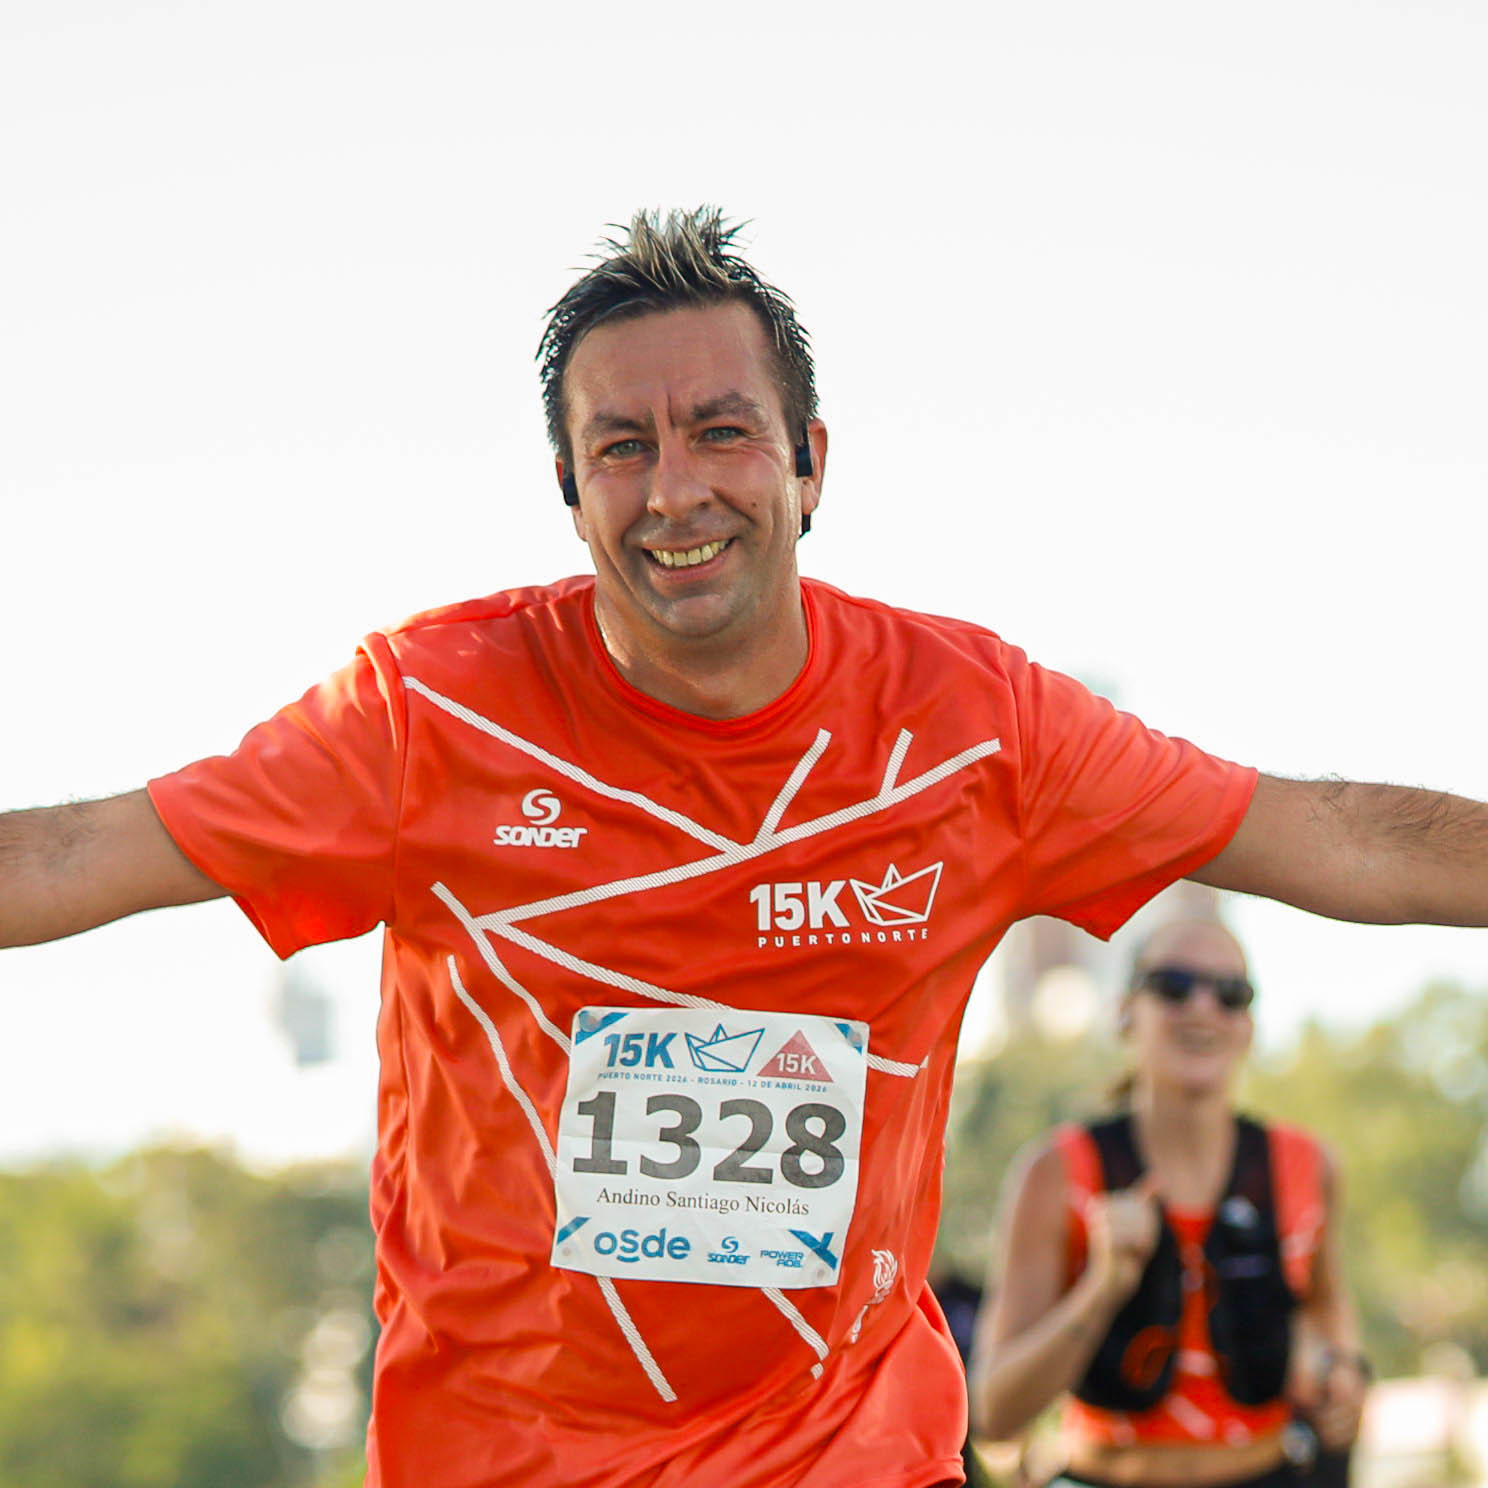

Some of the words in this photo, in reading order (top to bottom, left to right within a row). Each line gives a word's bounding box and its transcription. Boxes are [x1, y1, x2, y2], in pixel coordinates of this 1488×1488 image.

[750, 880, 851, 931] 15K
[758, 933, 852, 948] PUERTO
[861, 928, 929, 943] NORTE
[603, 1032, 678, 1069] 15K
[775, 1052, 817, 1075] 15K
[598, 1072, 631, 1080] PUERTO
[634, 1073, 663, 1081] NORTE
[698, 1076, 737, 1086] ROSARIO
[761, 1081, 772, 1089] DE
[776, 1082, 802, 1091] ABRIL
[573, 1090, 847, 1189] 1328
[596, 1187, 660, 1206] Andino
[665, 1191, 740, 1215] Santiago
[745, 1195, 810, 1215] Nicolás
[594, 1227, 691, 1261] osde
[760, 1249, 804, 1260] POWER
